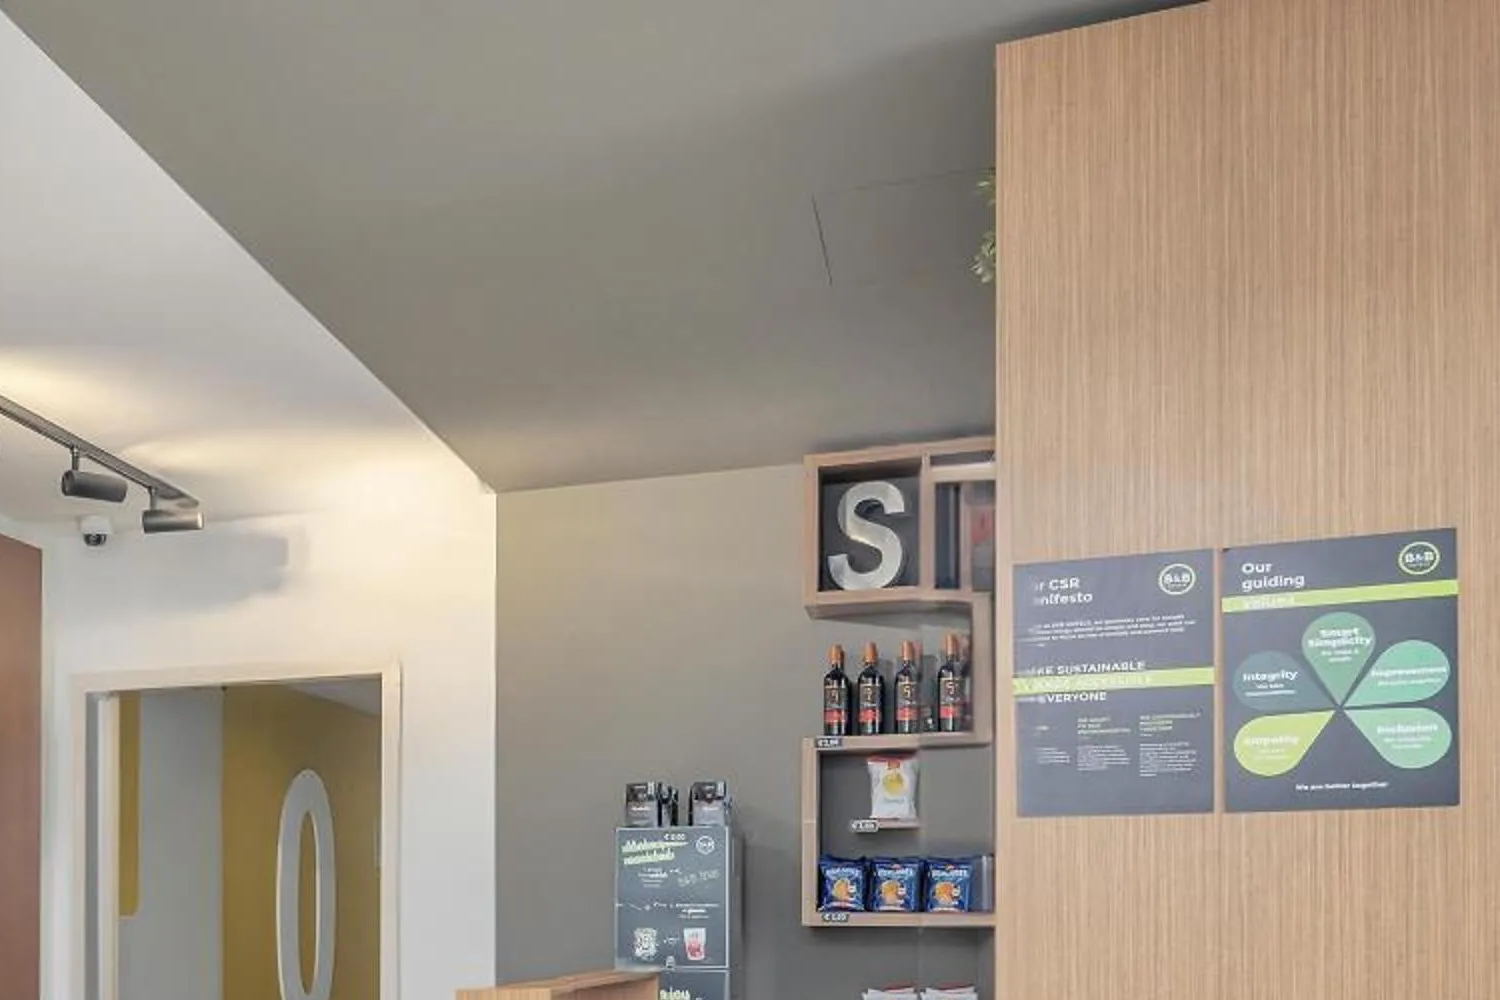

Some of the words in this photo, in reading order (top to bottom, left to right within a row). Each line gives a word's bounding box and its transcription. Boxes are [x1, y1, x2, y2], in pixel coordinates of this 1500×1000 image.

[828, 480, 905, 590] S
[1241, 562, 1272, 574] Our
[1049, 577, 1081, 591] CSR
[1241, 576, 1306, 592] guiding
[1243, 669, 1298, 682] Integrity
